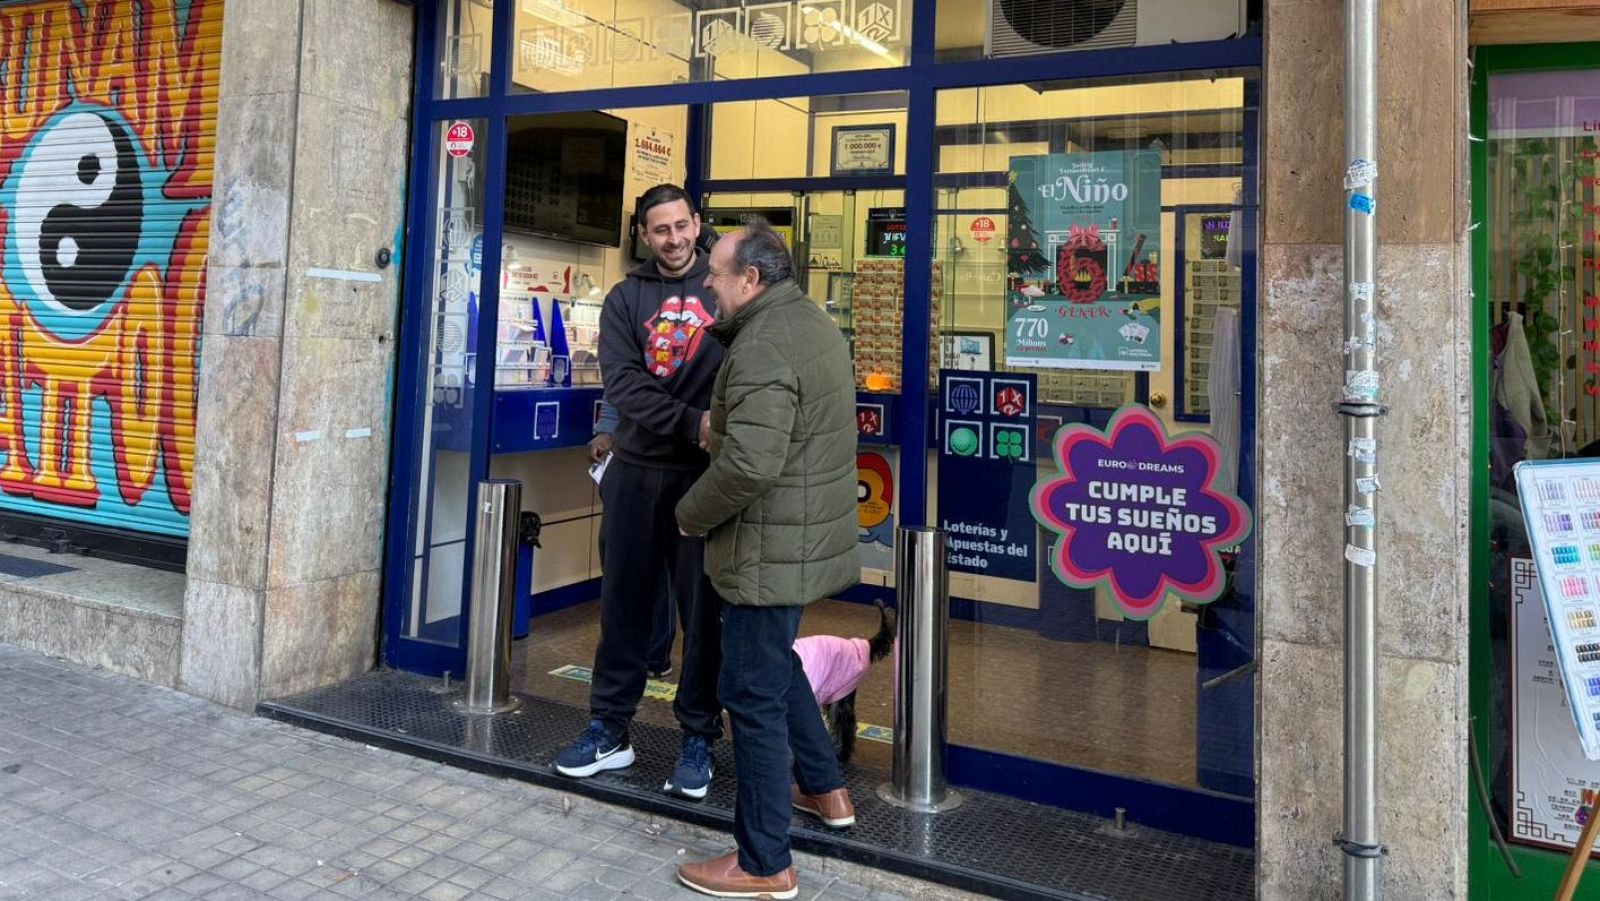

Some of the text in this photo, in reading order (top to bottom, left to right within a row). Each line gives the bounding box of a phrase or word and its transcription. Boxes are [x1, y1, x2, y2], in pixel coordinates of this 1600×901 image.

[1055, 175, 1128, 205] Niño
[1059, 305, 1109, 318] GENER
[1015, 317, 1049, 338] 770
[1098, 458, 1185, 474] EURO DREAMS
[1088, 480, 1187, 507] CUMPLE
[1066, 502, 1217, 534] TUS SUEÑOS
[943, 519, 1008, 541] Loterías y
[1007, 543, 1028, 558] del
[1107, 531, 1173, 556] AQUÍ
